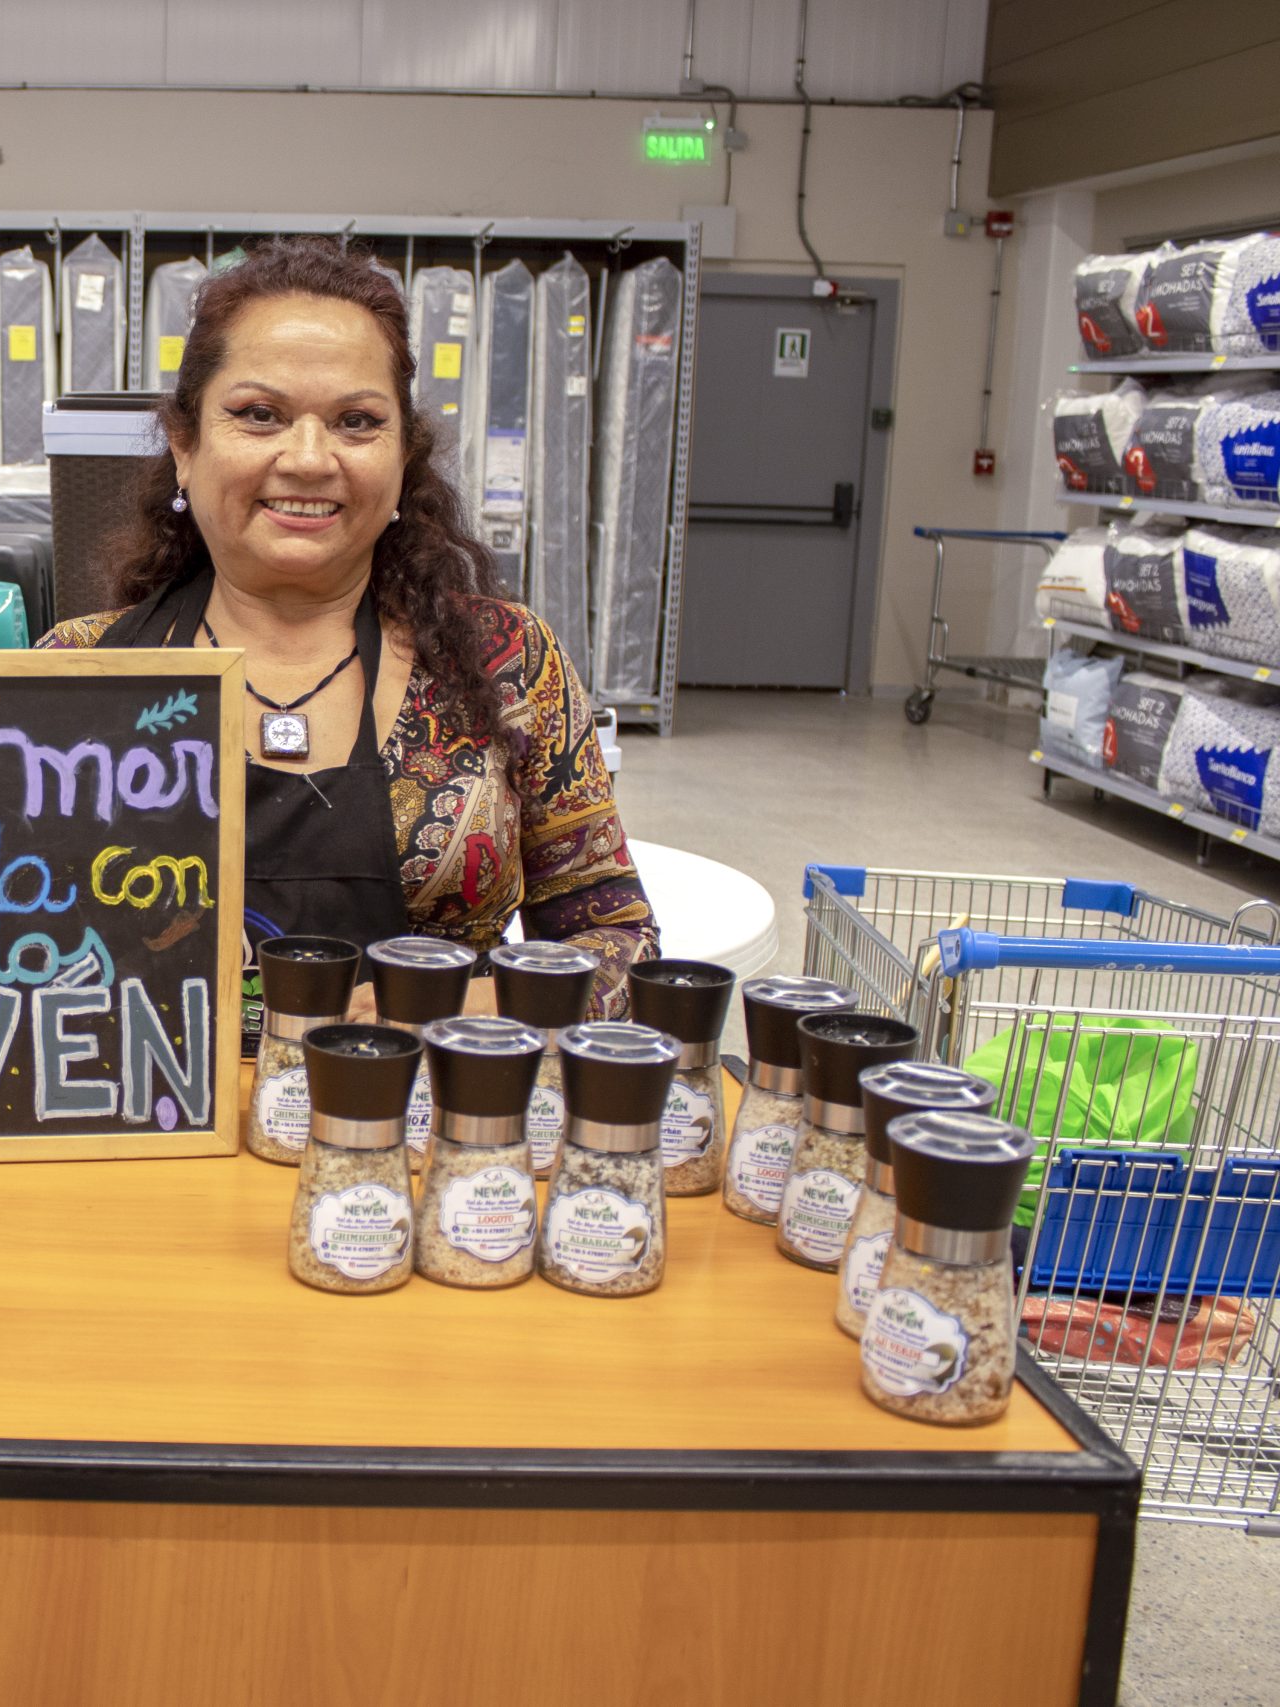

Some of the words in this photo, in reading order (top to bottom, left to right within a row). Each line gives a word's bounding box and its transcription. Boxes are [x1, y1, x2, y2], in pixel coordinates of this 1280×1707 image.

[646, 135, 705, 160] SALIDA
[283, 1087, 308, 1097] NEW
[474, 1185, 516, 1198] NEWEN
[344, 1202, 388, 1217] NEWEN
[575, 1206, 619, 1222] NEWEN
